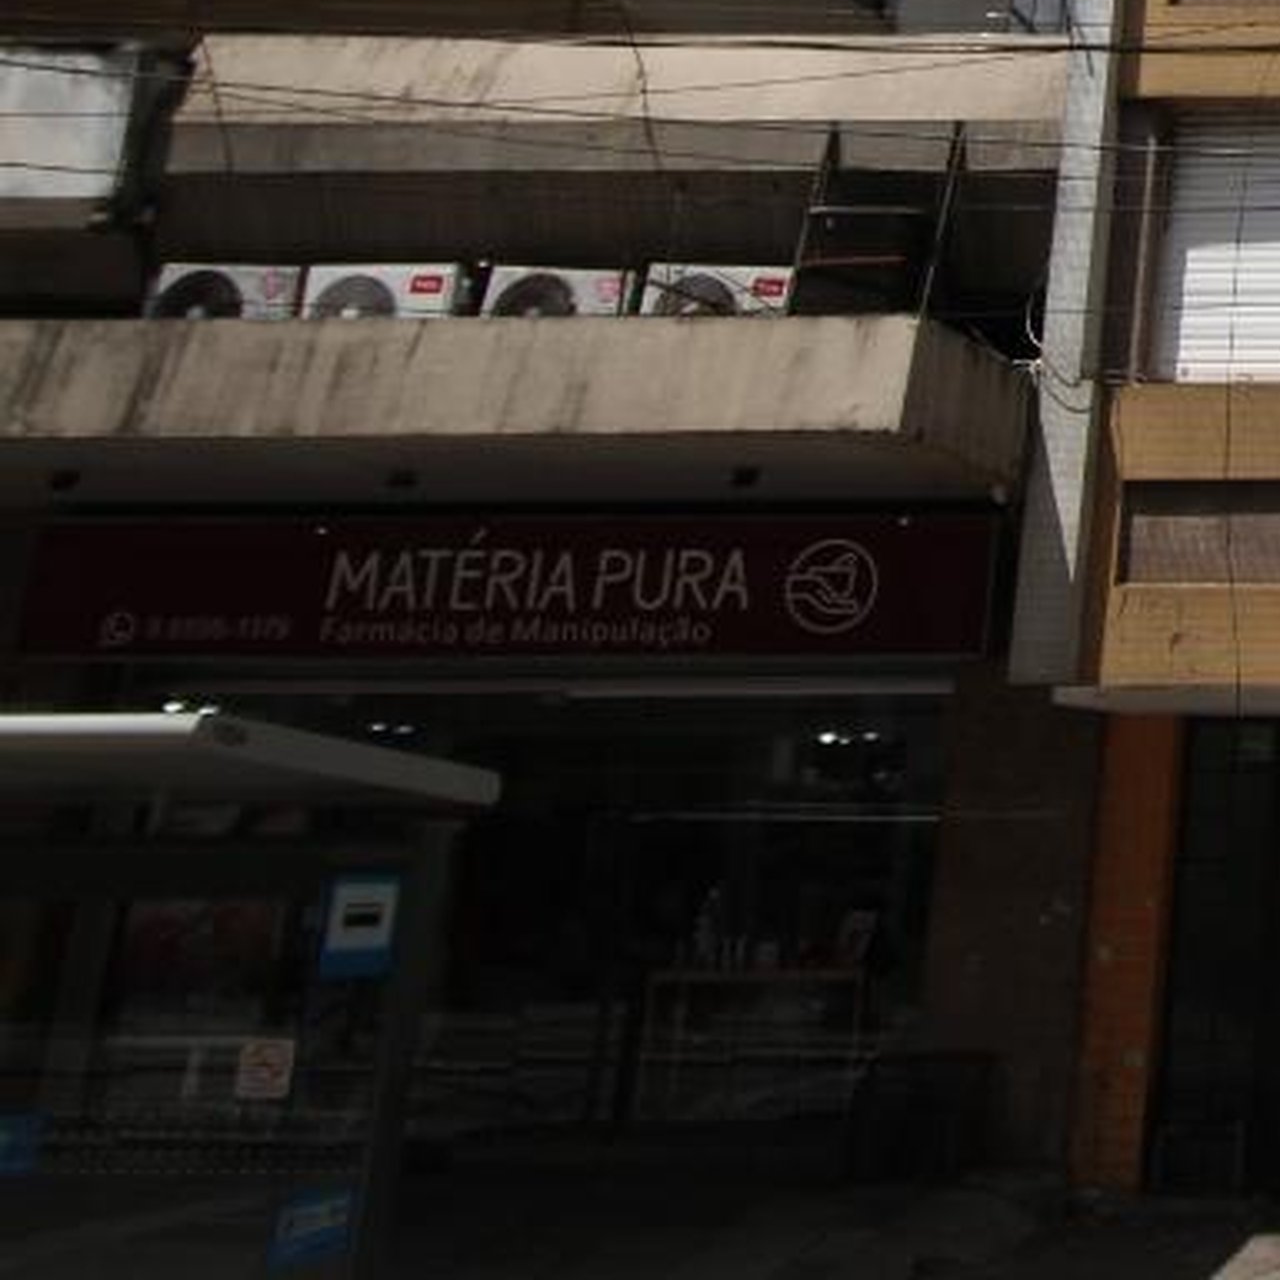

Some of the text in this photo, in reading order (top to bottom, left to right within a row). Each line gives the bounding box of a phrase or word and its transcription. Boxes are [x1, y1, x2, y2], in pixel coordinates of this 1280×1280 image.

[325, 527, 750, 612] MATÉRIA PURA
[319, 617, 712, 650] Farmácia de Manipulação
